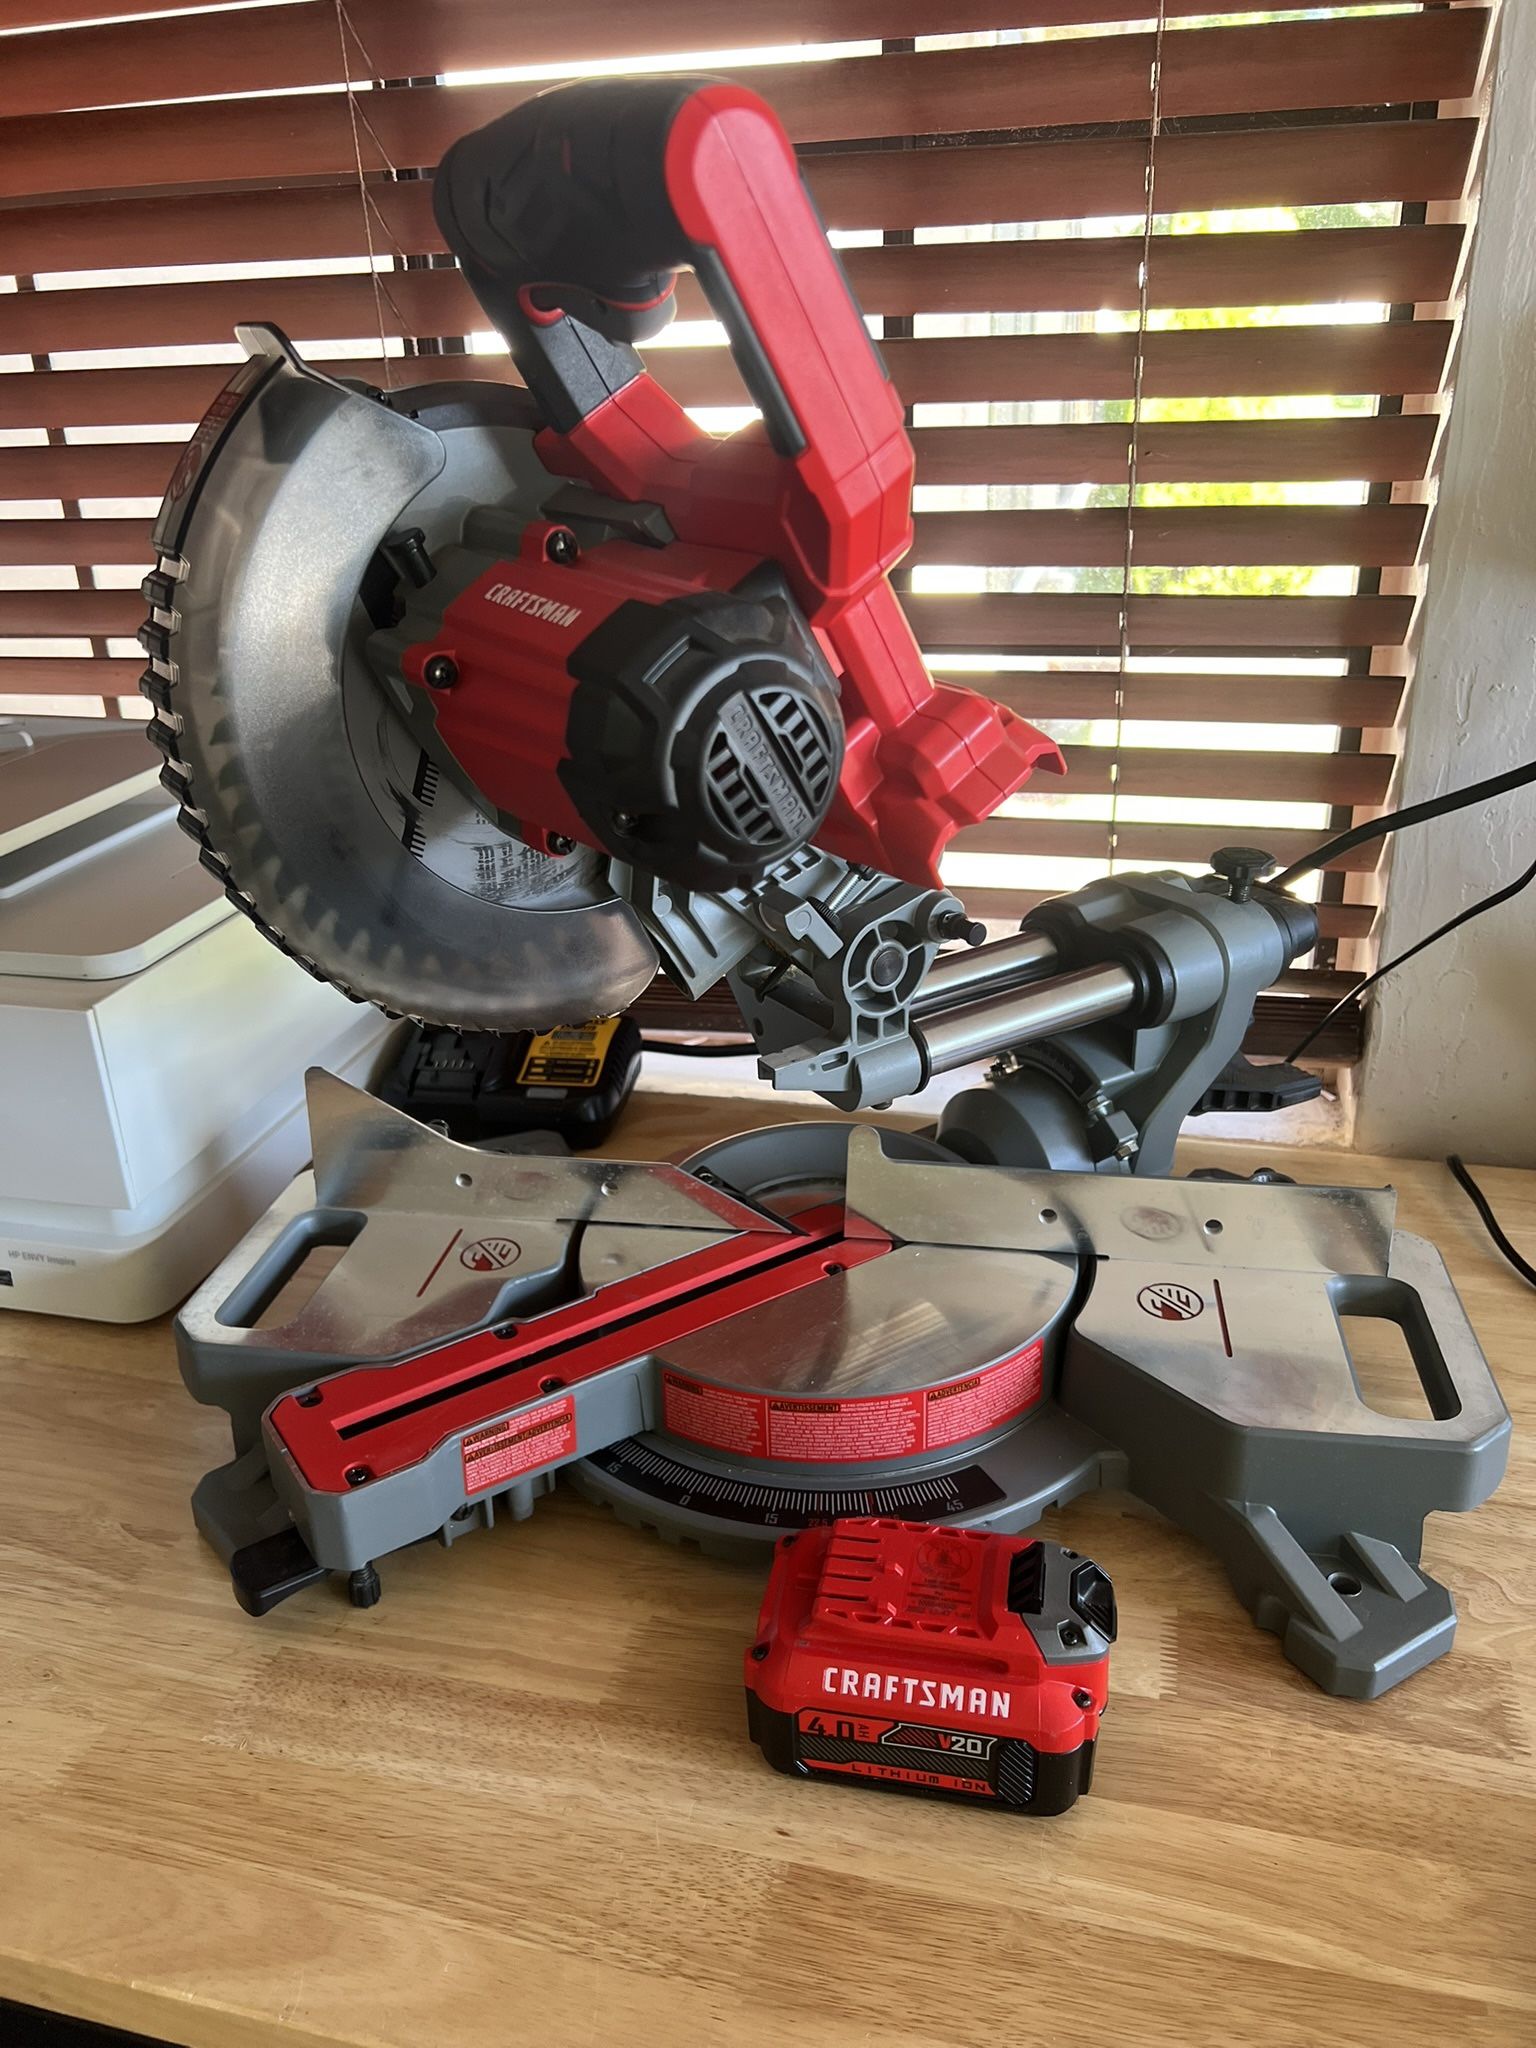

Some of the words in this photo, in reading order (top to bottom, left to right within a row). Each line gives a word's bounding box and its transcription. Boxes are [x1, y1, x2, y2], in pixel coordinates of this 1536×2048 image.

[484, 583, 582, 627] CRAFTSMAN
[730, 703, 806, 835] CRAFTSMAN
[8, 1249, 20, 1259] HP
[22, 1251, 45, 1262] ENVY
[606, 1461, 623, 1473] 15
[679, 1494, 691, 1506] 0
[946, 1499, 965, 1512] 45
[764, 1512, 779, 1525] 15
[823, 1666, 1011, 1719] CRAFTSMAN
[807, 1716, 855, 1741] 4.0
[937, 1733, 983, 1755] V20
[851, 1763, 940, 1785] LITHIUM
[954, 1779, 987, 1792] ION
